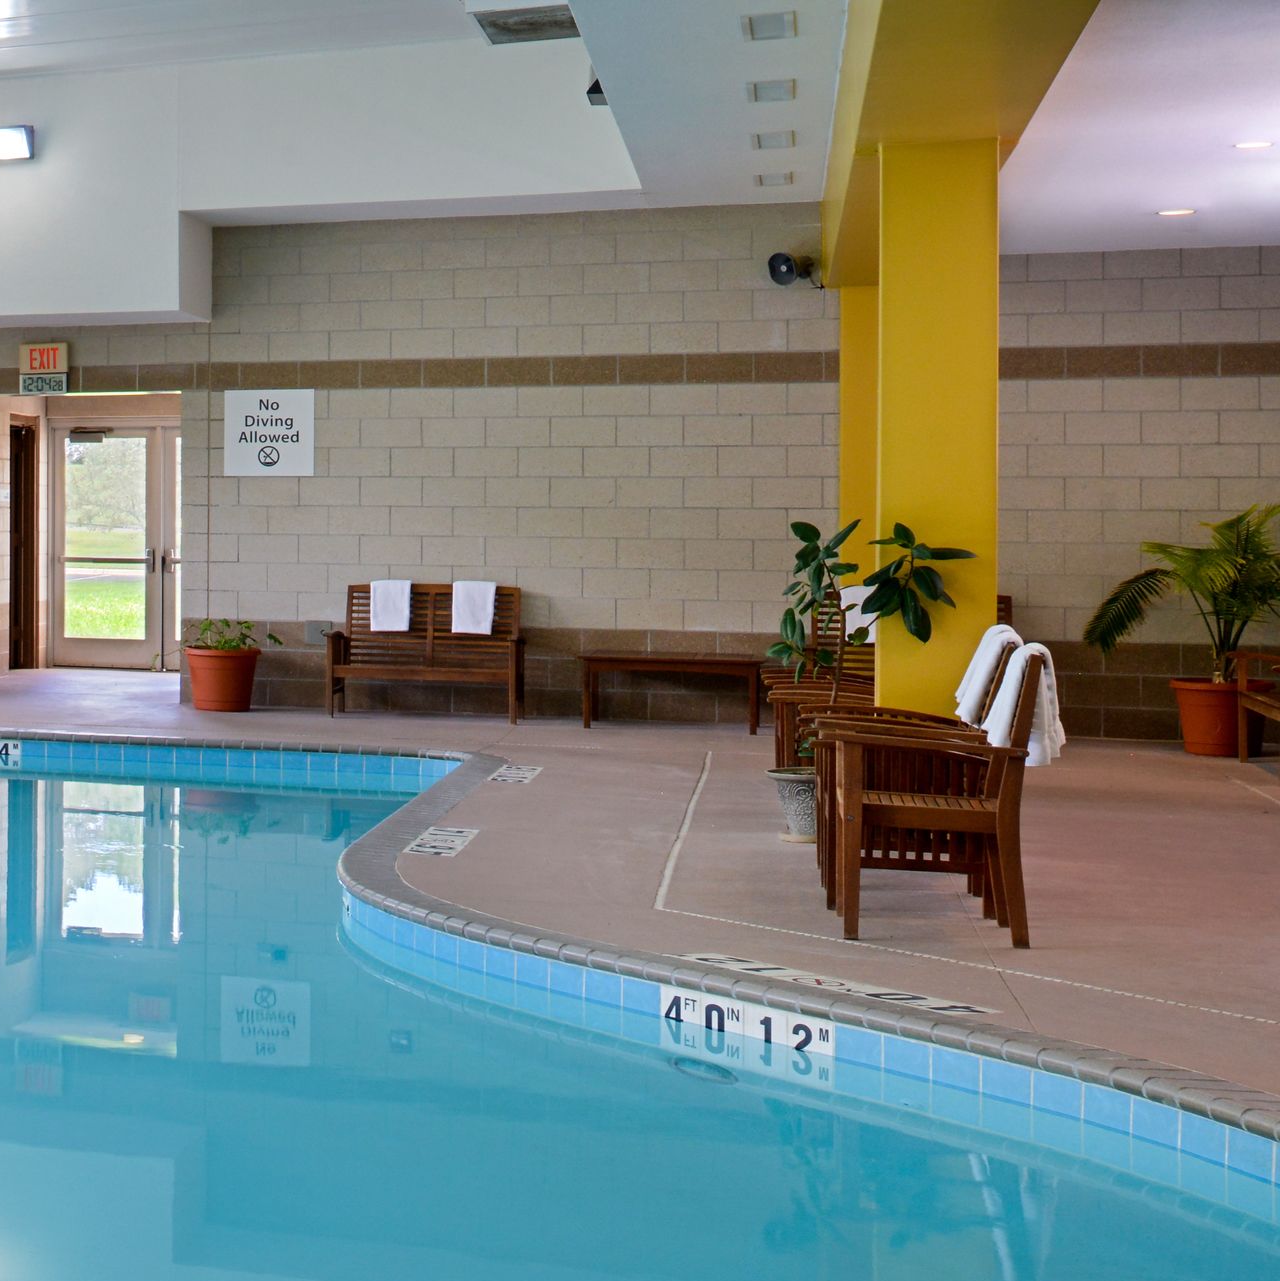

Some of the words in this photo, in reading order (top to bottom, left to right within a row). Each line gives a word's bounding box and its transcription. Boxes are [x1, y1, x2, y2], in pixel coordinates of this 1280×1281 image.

[29, 347, 59, 370] EXIT
[259, 398, 280, 411] No
[244, 415, 294, 430] Diving
[238, 430, 300, 443] Allowed
[684, 998, 697, 1013] FT
[727, 1007, 740, 1022] IN
[819, 1027, 830, 1043] M
